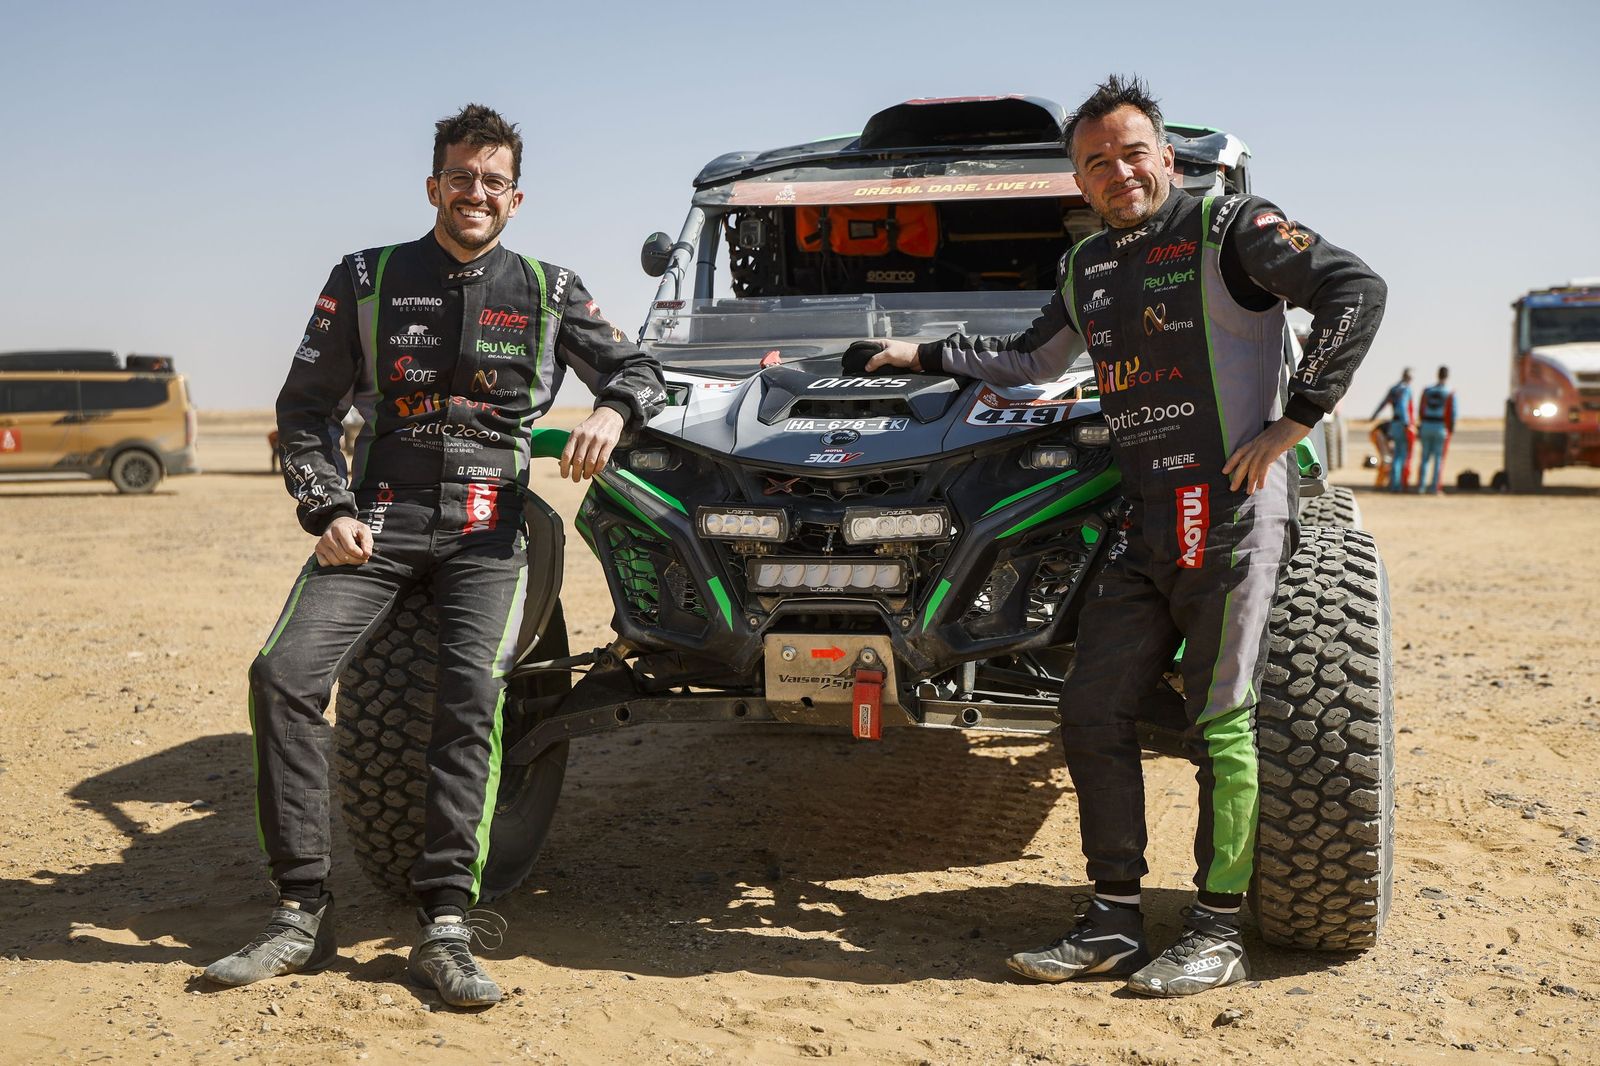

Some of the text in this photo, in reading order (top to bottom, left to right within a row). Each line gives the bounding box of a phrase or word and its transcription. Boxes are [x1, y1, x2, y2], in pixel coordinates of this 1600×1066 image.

[854, 180, 1050, 196] DREAM. DARE. LIVE IT.
[1211, 195, 1241, 234] HRX
[1256, 214, 1285, 228] MOT
[1116, 227, 1149, 249] HRX
[448, 266, 485, 280] HRX
[1084, 260, 1119, 276] MATIMMO
[866, 270, 916, 283] sparco
[1143, 268, 1196, 292] Feu Vert
[551, 268, 569, 303] HRX
[392, 297, 443, 306] MATIMMO
[1083, 297, 1115, 313] SYSTEMIC
[389, 336, 442, 346] SYSTEMIC
[476, 340, 527, 356] Feu Vert
[1128, 366, 1184, 388] SOFA
[975, 408, 1058, 424] 419
[1140, 402, 1195, 425] 2000
[454, 424, 501, 441] 2000
[789, 420, 902, 430] HA-678-FK
[804, 452, 864, 463] 300V
[1152, 452, 1195, 470] B. RIVIERE
[466, 466, 502, 477] PERNAUT
[1182, 487, 1203, 567] MOTUL
[1183, 955, 1223, 975] sparco
